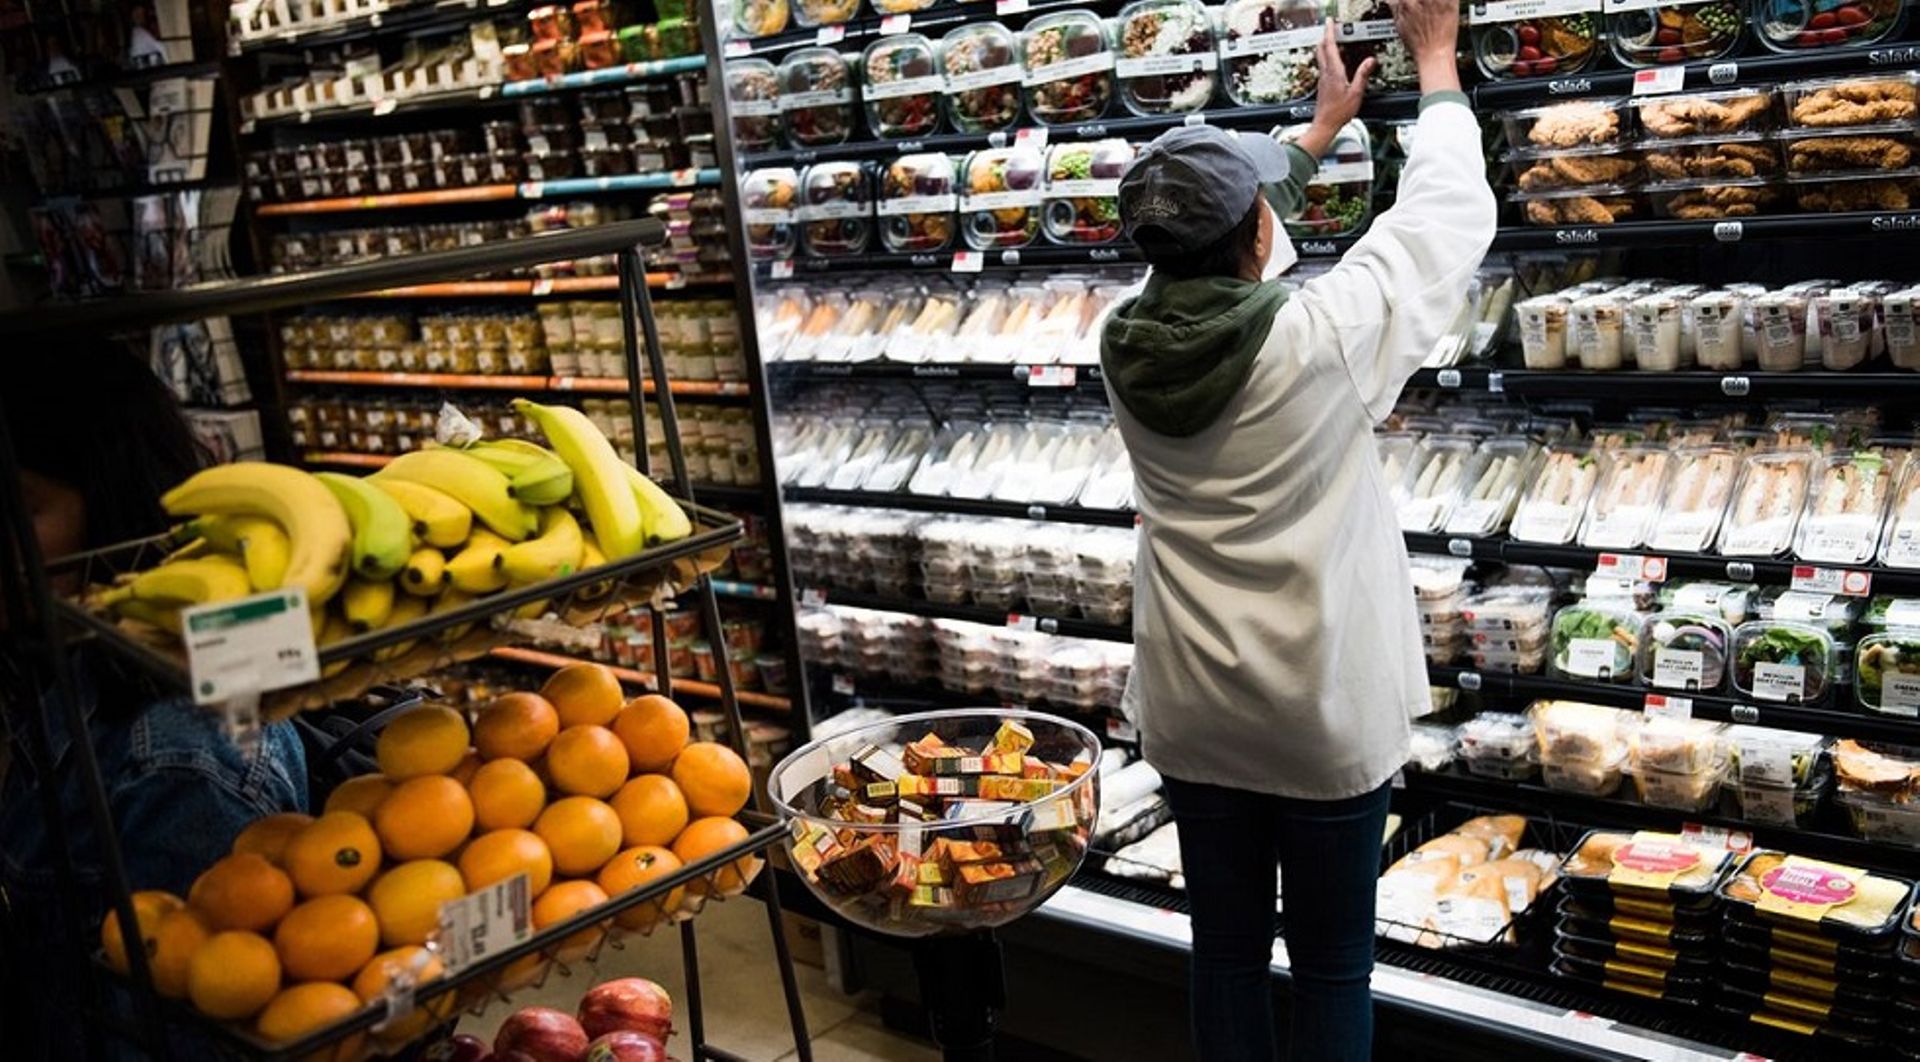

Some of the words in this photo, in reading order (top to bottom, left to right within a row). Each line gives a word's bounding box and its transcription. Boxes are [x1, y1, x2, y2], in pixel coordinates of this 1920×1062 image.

[1549, 79, 1591, 94] Salads
[1557, 229, 1599, 243] Salads
[1302, 241, 1336, 253] Salads
